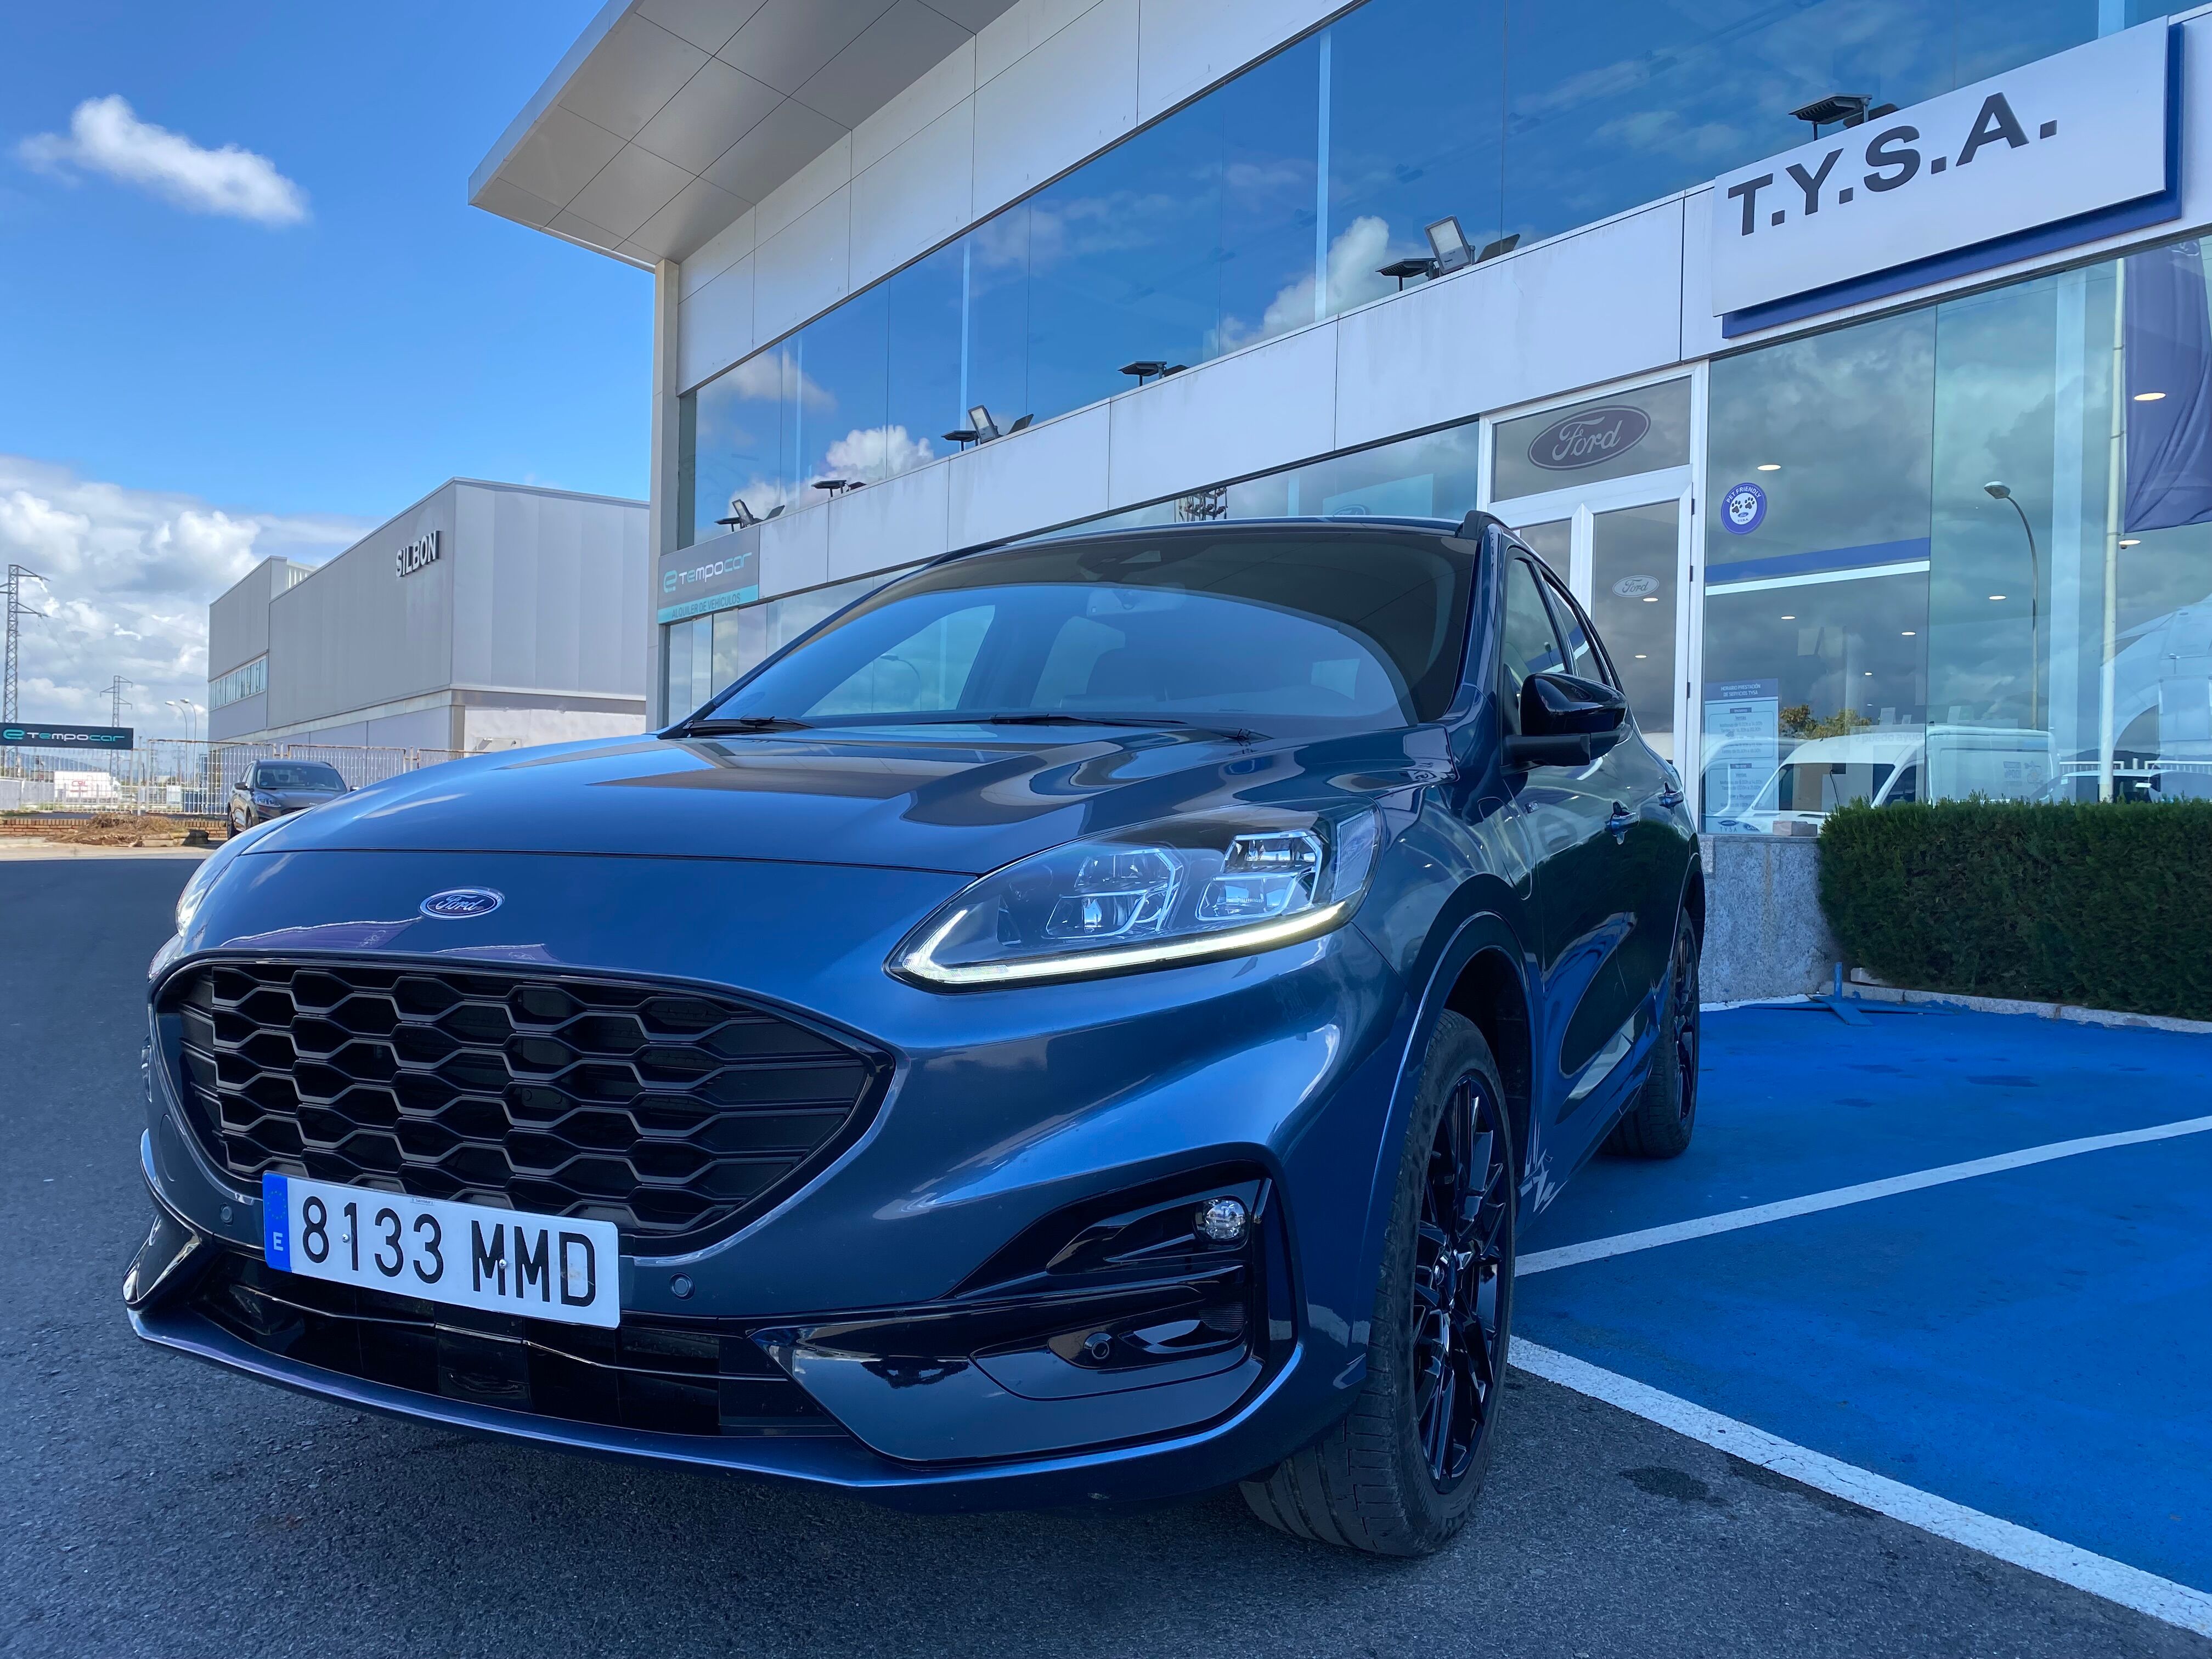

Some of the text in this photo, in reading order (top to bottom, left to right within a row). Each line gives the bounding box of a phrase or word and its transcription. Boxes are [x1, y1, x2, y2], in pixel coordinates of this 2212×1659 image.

[1728, 92, 2057, 236] T.Y.S.A.
[1551, 416, 1623, 461] Ford
[1726, 486, 1762, 503] PET FRIENDLY
[396, 530, 439, 577] SILBON
[1622, 579, 1649, 593] Ford
[672, 592, 741, 619] ALQUILER DE VEHÍCULOS
[435, 894, 485, 911] Ford
[273, 1232, 284, 1251] E
[302, 1195, 597, 1307] 8133 MMD
